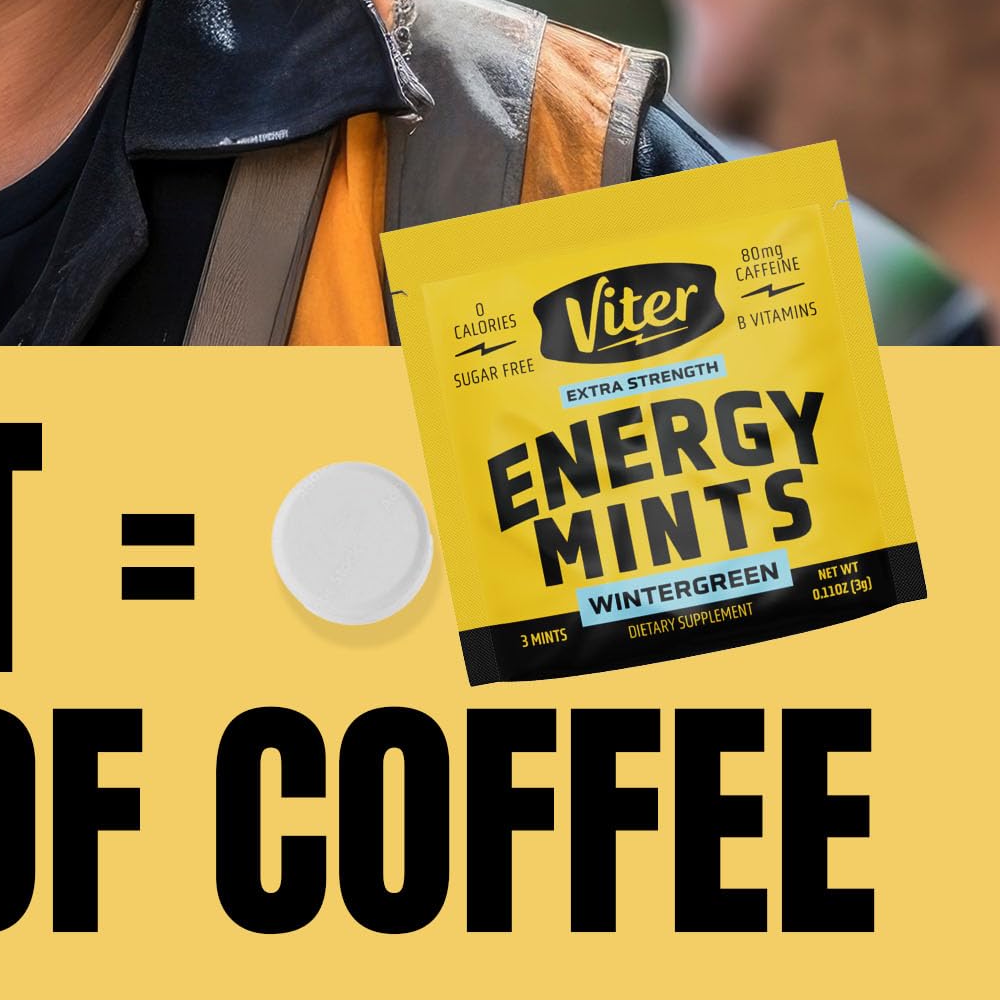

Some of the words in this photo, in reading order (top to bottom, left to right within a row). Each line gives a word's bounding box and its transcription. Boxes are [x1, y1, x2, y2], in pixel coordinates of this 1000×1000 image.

[740, 243, 784, 263] 80mg
[735, 256, 801, 282] CAFFEINE
[475, 303, 485, 317] 0
[565, 276, 699, 354] Viter
[737, 316, 747, 330] B
[749, 302, 818, 328] VITAMINS
[453, 313, 518, 340] CALORIES
[453, 366, 499, 388] SUGAR
[502, 358, 535, 379] FREE
[566, 380, 624, 402] EXTRA
[627, 360, 719, 390] STRENGTH
[487, 390, 825, 532] ENERGY
[533, 468, 813, 587] MINTS
[818, 565, 838, 580] NET
[841, 561, 859, 576] WT
[588, 562, 779, 616] WINTERGREEN
[628, 618, 675, 640] DIETARY
[679, 602, 754, 630] SUPPLEMENT
[520, 635, 529, 648] 3
[531, 628, 568, 647] MINTS
